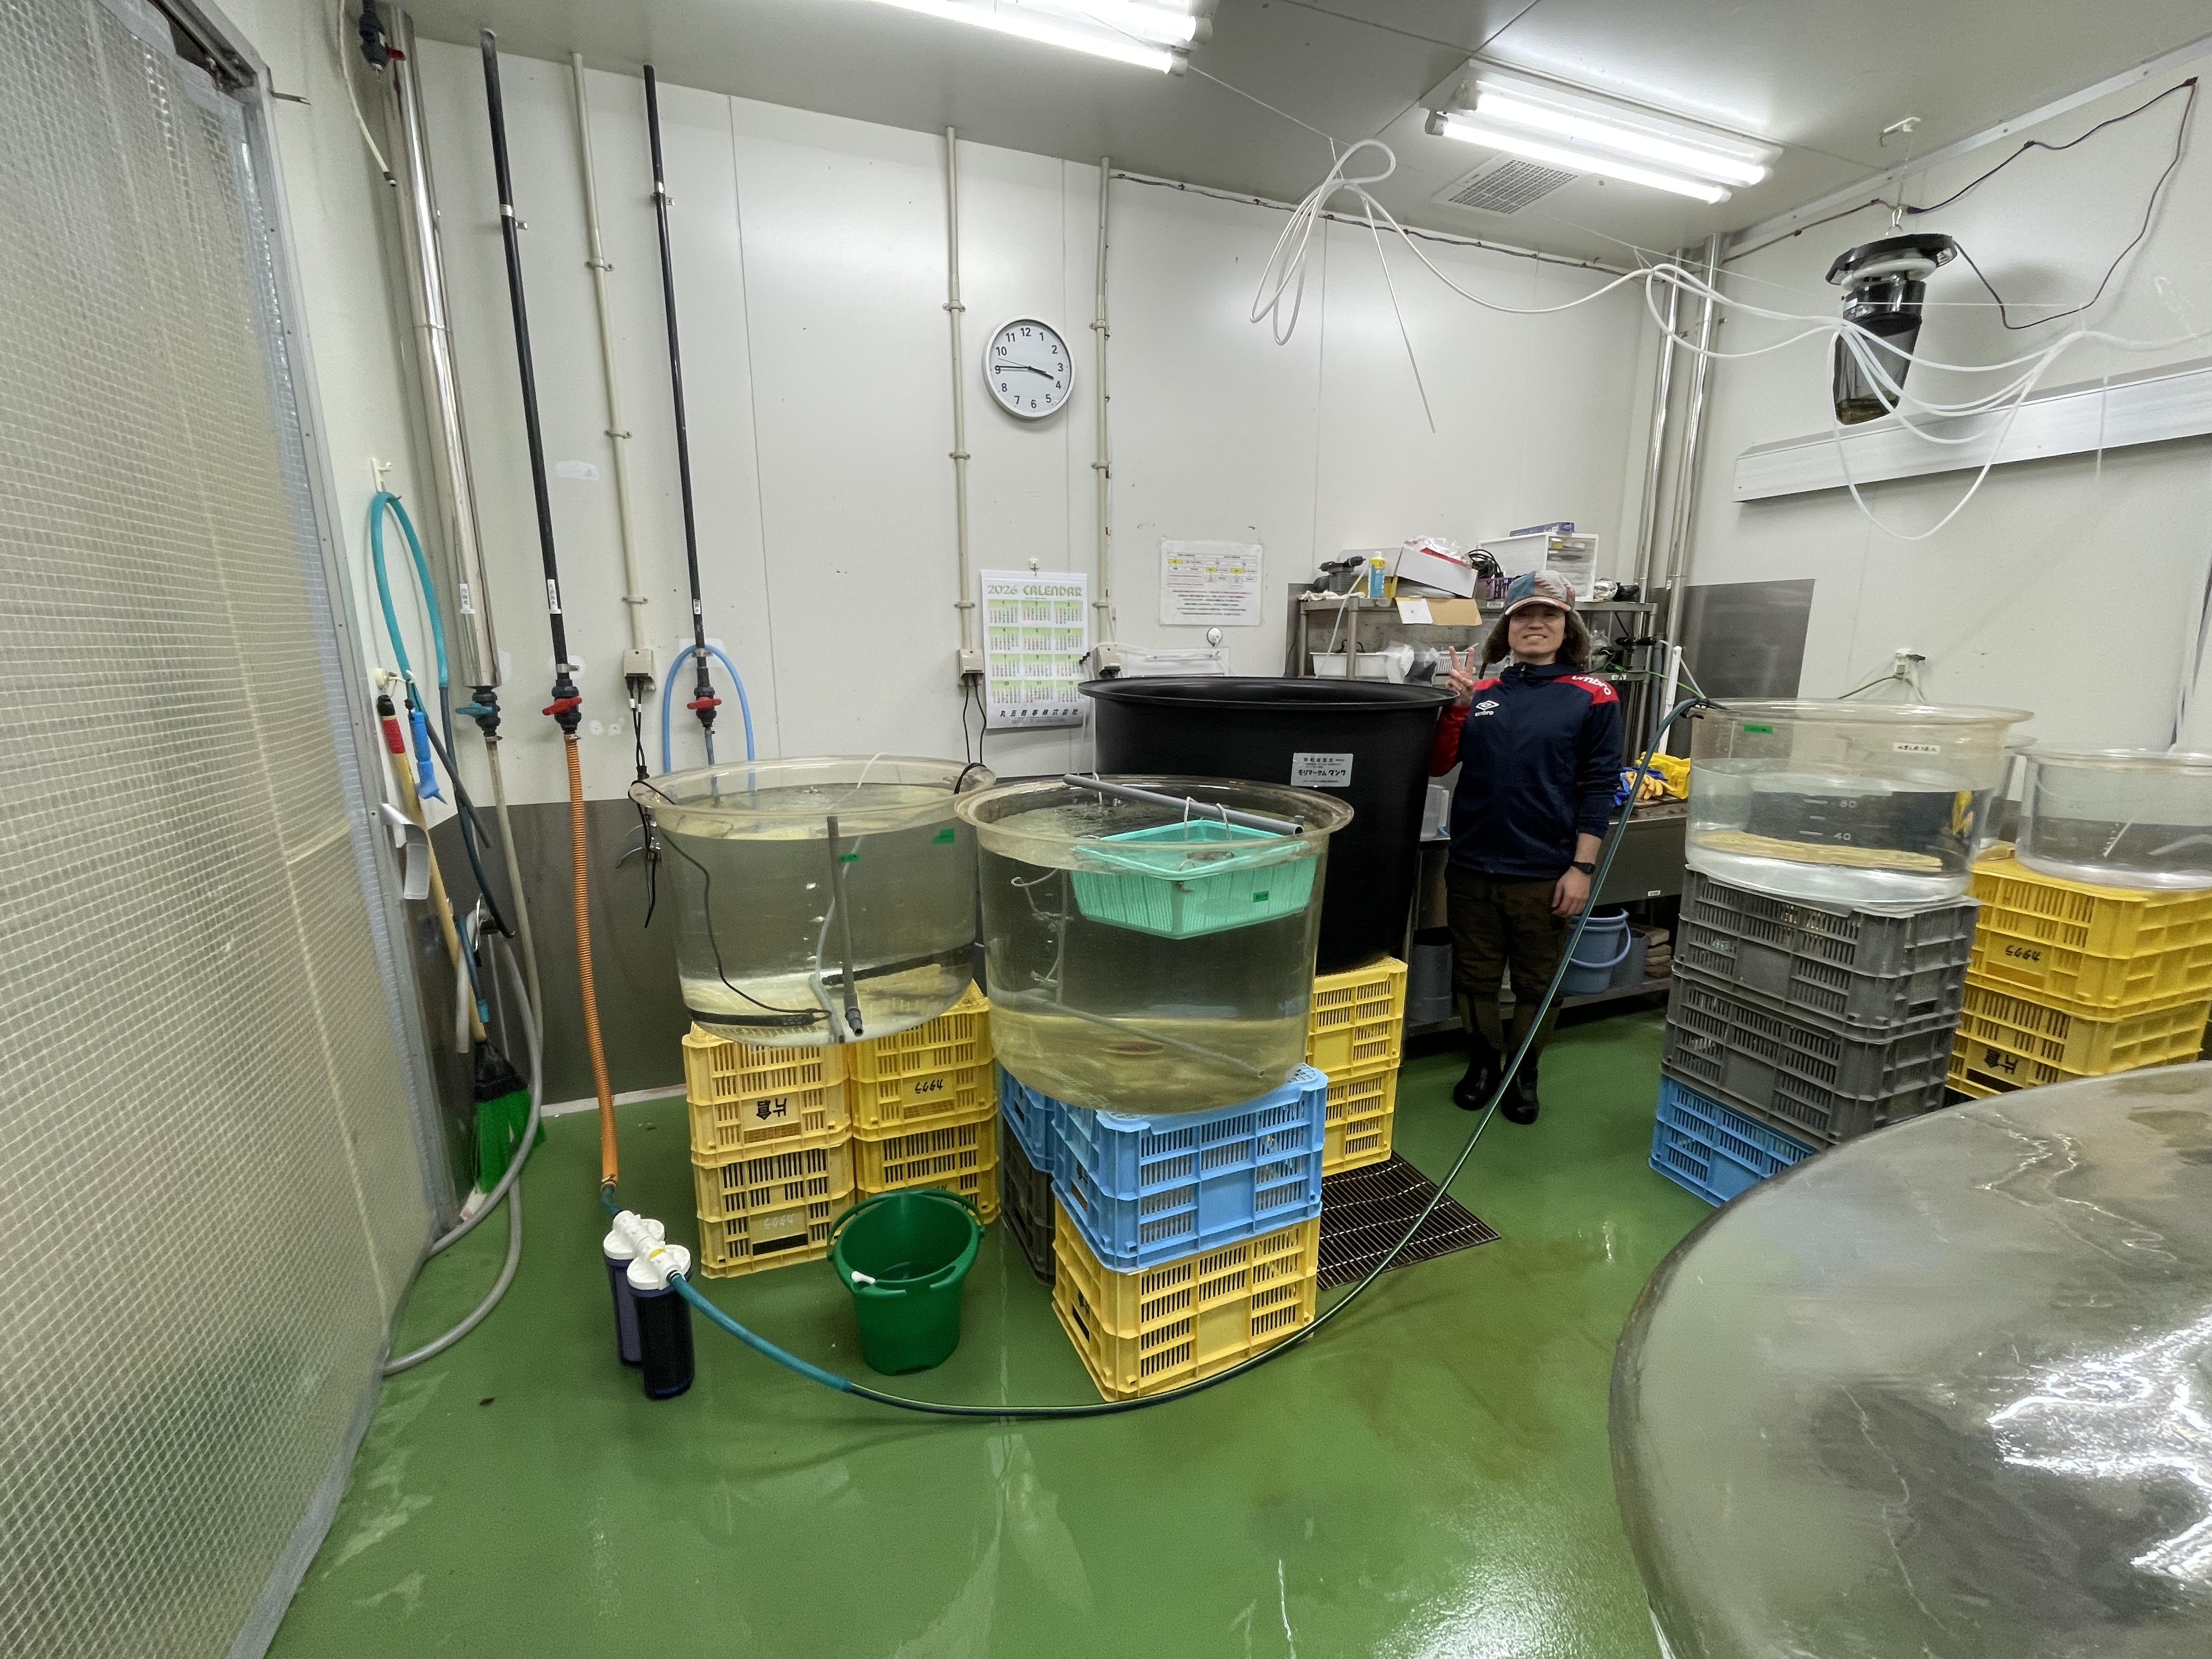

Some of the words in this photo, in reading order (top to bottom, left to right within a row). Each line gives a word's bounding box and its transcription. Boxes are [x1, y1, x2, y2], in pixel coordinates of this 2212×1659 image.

[1006, 332, 1015, 342] 11
[1020, 327, 1031, 337] 12
[1039, 332, 1044, 341] 1
[996, 346, 1007, 356] 10
[1052, 345, 1058, 354] 2
[995, 365, 1001, 374] 9
[1058, 363, 1064, 372] 3
[1001, 383, 1007, 392] 8
[1056, 381, 1062, 390] 4
[1014, 396, 1020, 404] 7
[1046, 394, 1052, 403] 5
[1031, 399, 1037, 409] 6
[987, 584, 1017, 595] 2026
[1023, 585, 1082, 597] CALENDAR
[1571, 675, 1612, 696] umbro
[1834, 832, 1851, 840] 40
[2005, 945, 2041, 961] カタクラ
[1984, 1048, 2019, 1075] 片倉
[915, 1079, 943, 1093] カタクラ
[755, 1098, 787, 1120] 片倉
[764, 1213, 795, 1229] カタクラ
